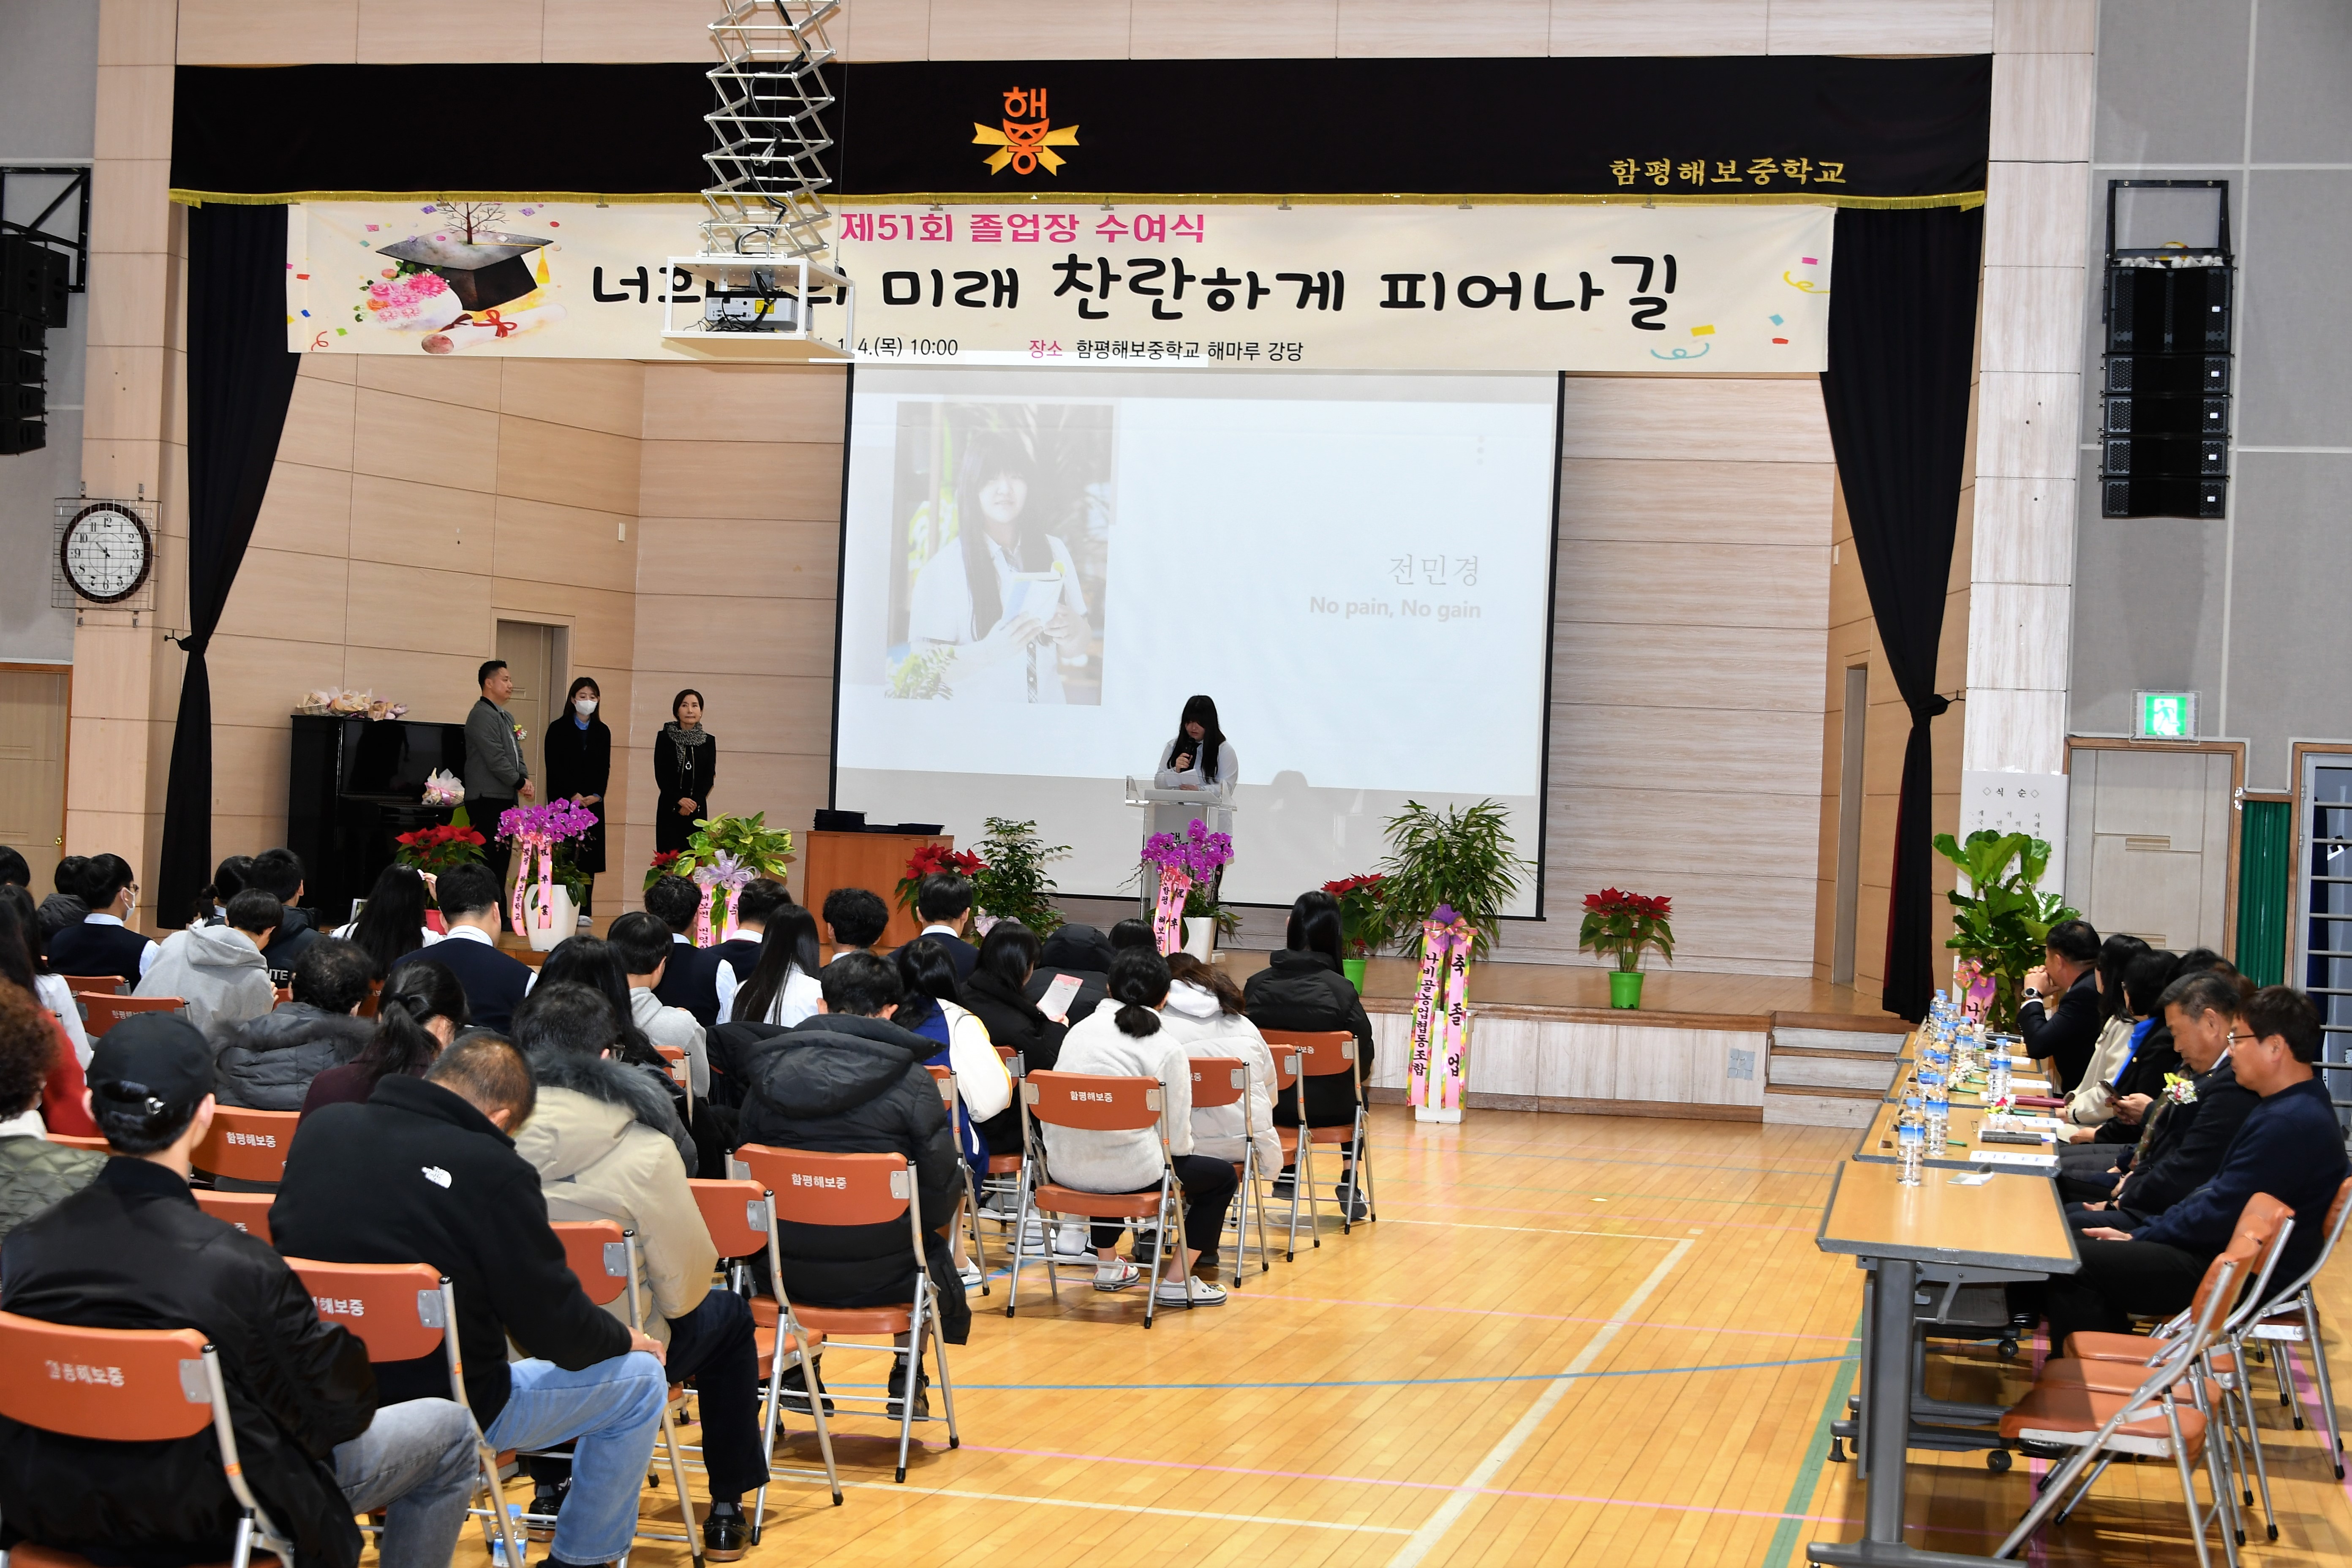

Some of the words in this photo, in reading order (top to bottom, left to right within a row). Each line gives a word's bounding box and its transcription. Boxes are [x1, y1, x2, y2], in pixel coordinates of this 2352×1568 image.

[1609, 157, 1846, 186] 함평해보중학교
[840, 213, 953, 242] 제51회
[970, 214, 1080, 243] 졸업장
[1095, 214, 1204, 244] 수여식
[882, 268, 1018, 309] 미래
[1052, 253, 1344, 320] 찬란하게
[1380, 254, 1677, 330] 피어나길
[858, 337, 902, 357] 4.(목)
[911, 339, 958, 356] 10:00
[1030, 339, 1062, 358] 장소
[1077, 340, 1200, 360] 함평해보중학교
[1208, 341, 1260, 361] 해마루
[1268, 342, 1304, 362] 강당
[91, 522, 96, 532] 11
[104, 517, 112, 528] 12
[120, 523, 123, 532] 1
[80, 534, 87, 543] 10
[128, 534, 134, 543] 2
[74, 548, 81, 558] 9
[132, 549, 139, 559] 3
[79, 564, 85, 574] 8
[128, 565, 134, 575] 4
[1388, 553, 1478, 586] 전민경
[90, 576, 96, 586] 7
[103, 579, 109, 590] 6
[117, 576, 123, 586] 5
[1310, 596, 1339, 614] No
[1345, 598, 1394, 619] pain,
[1402, 599, 1432, 617] No
[1437, 600, 1481, 623] gain
[1070, 1090, 1113, 1102] 함평해보중
[226, 1131, 276, 1148] 함평해보중
[792, 1173, 847, 1190] 함평해보중
[312, 1296, 365, 1317] 해보중
